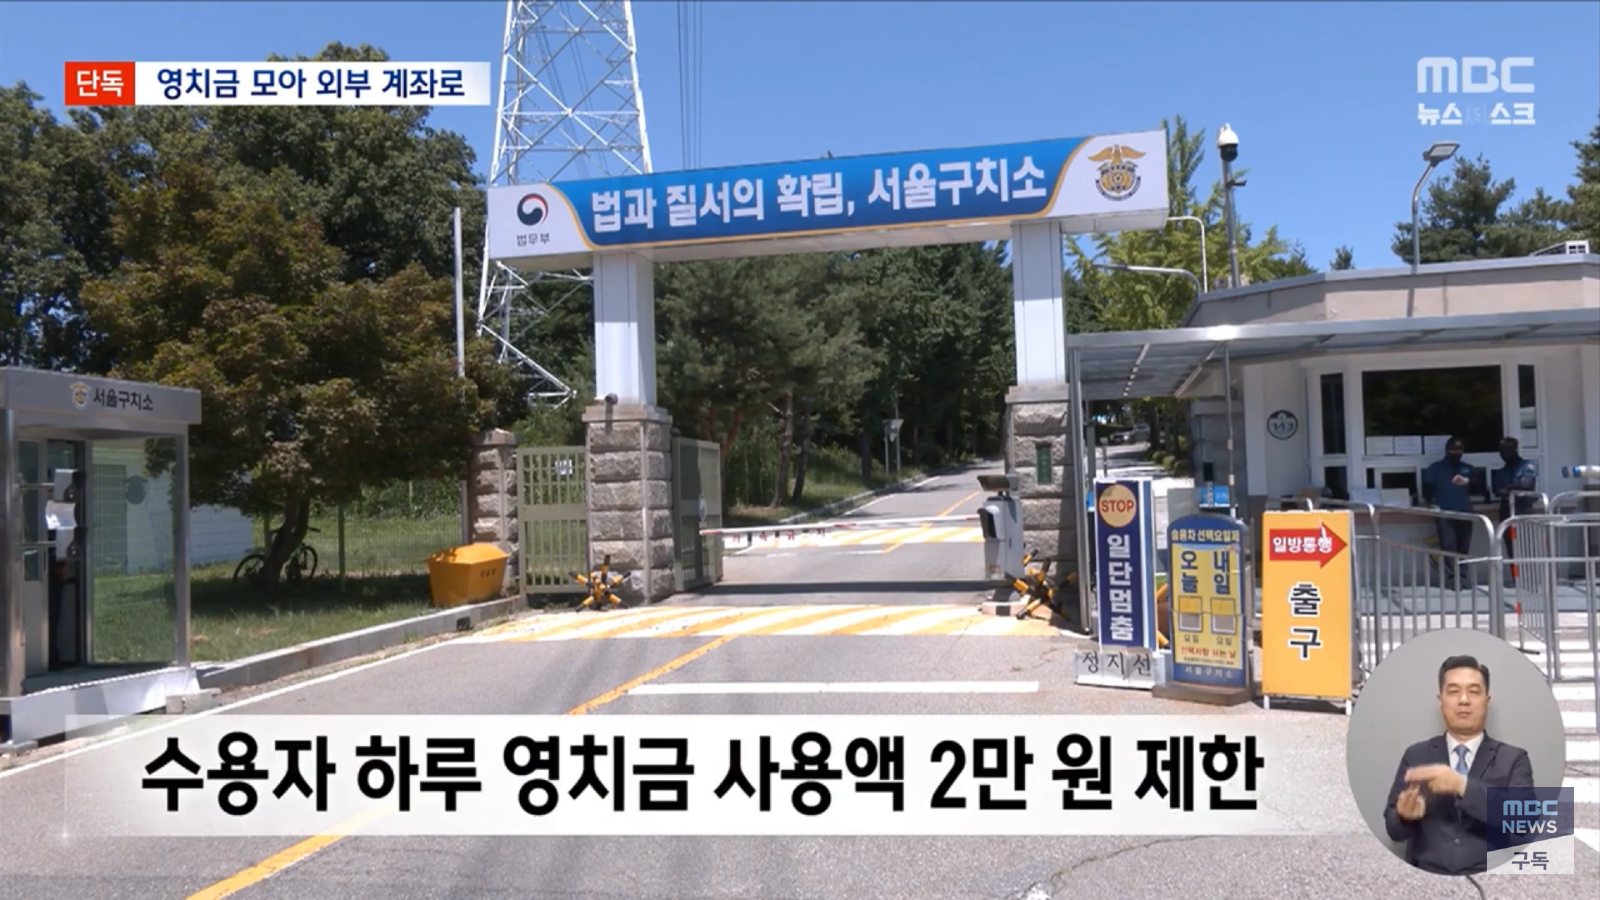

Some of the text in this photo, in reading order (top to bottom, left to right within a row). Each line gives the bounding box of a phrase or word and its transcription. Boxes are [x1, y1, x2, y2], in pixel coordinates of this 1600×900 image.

[592, 155, 1047, 233] 법과 질서의 확립, 서울구치소
[516, 232, 550, 247] 법무부
[93, 387, 154, 411] 서울구치소
[1100, 500, 1134, 513] STOP
[1272, 535, 1333, 555] 일방통행
[1106, 534, 1134, 642] 일단멈춤
[1181, 550, 1199, 593] 오늘
[1213, 551, 1231, 595] 내일
[1289, 583, 1321, 660] 출구
[1082, 650, 1151, 677] 정지선
